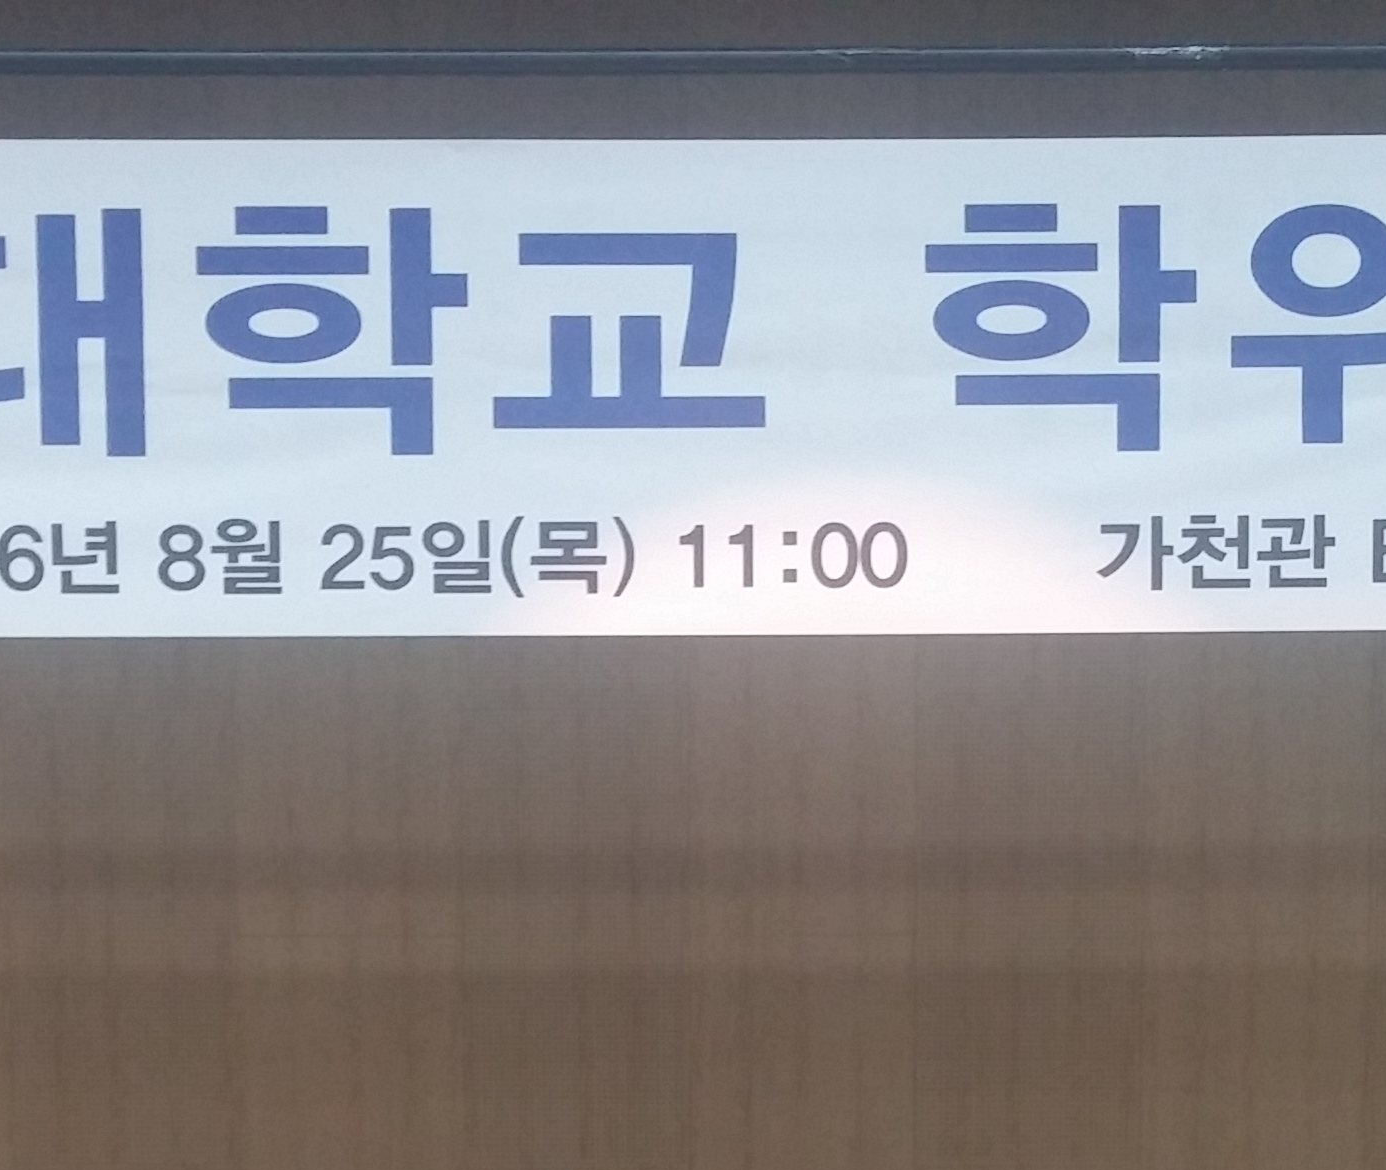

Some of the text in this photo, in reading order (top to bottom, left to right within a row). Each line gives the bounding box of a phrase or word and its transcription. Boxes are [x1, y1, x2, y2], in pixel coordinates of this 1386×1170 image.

[157, 517, 282, 595] 8월
[319, 515, 635, 597] 25일(목)
[679, 521, 907, 588] 11:00
[1095, 513, 1336, 591] 가천관
